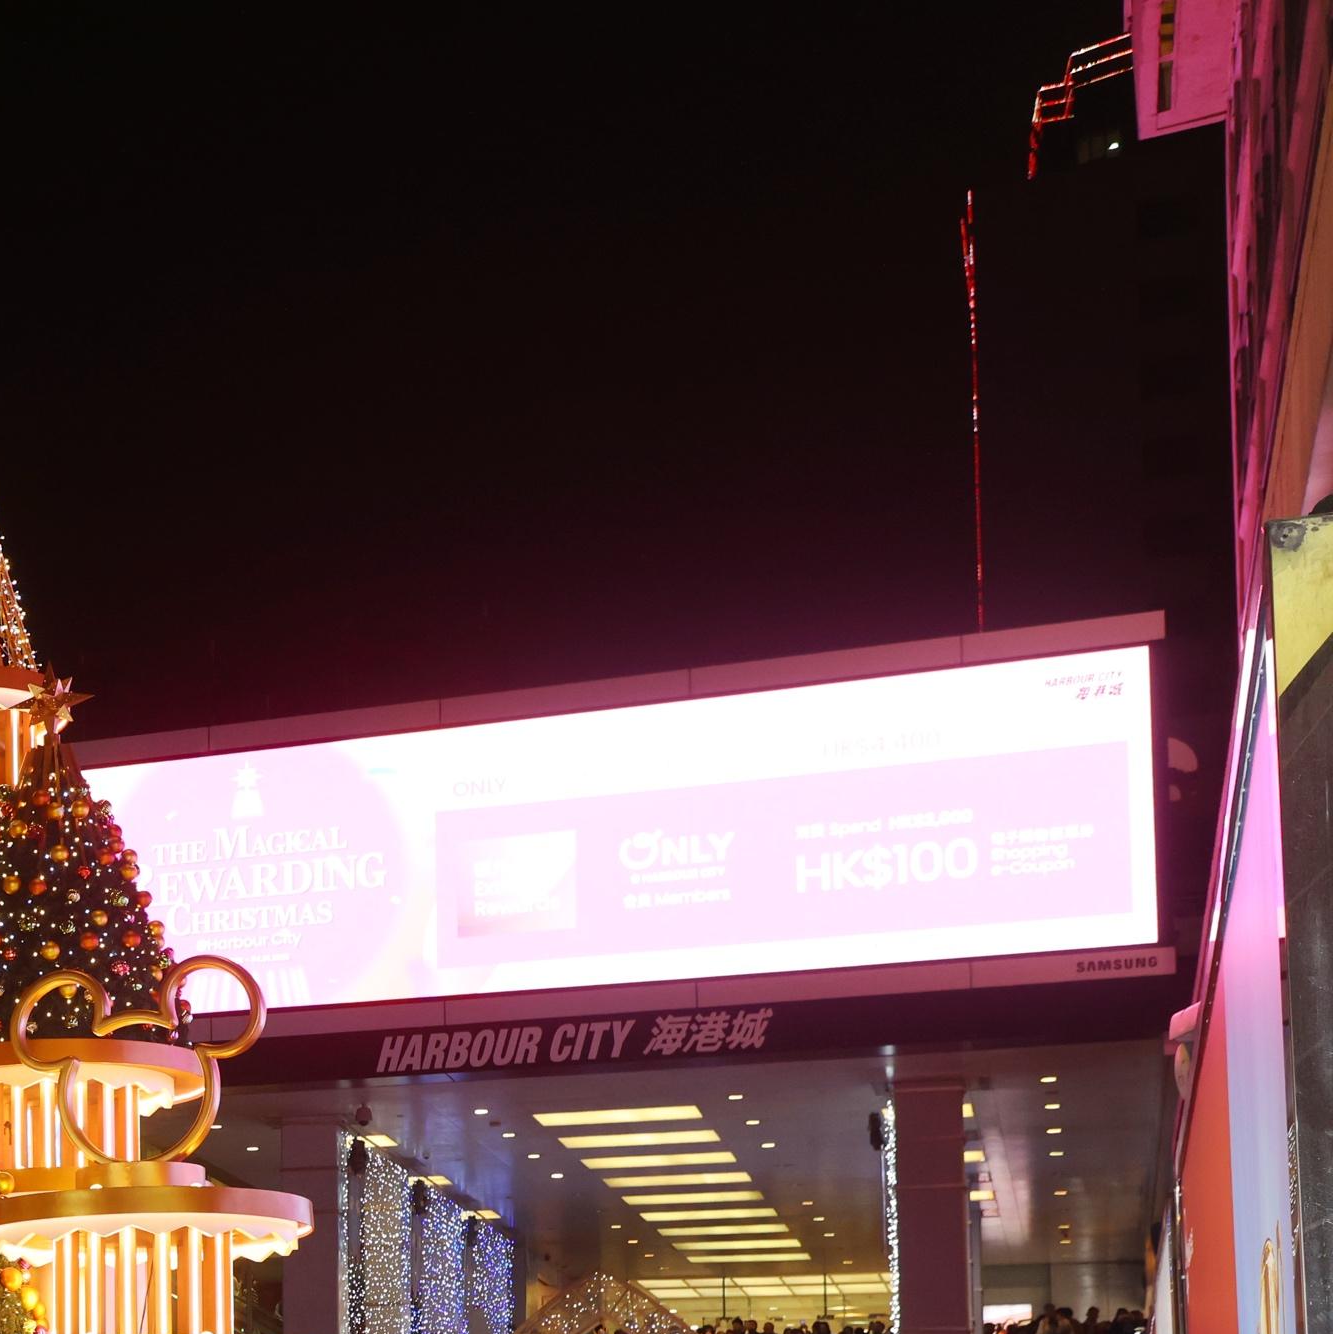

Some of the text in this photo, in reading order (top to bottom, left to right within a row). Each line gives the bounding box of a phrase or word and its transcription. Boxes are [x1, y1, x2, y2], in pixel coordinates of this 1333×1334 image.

[452, 777, 507, 798] ONLY
[151, 824, 348, 867] THE MAGICAL
[795, 837, 978, 893] HK$100
[165, 900, 335, 937] CHRISTMAS
[1076, 956, 1158, 973] SAMSUNG
[376, 1007, 774, 1073] HARBOUR CITY 海港城
